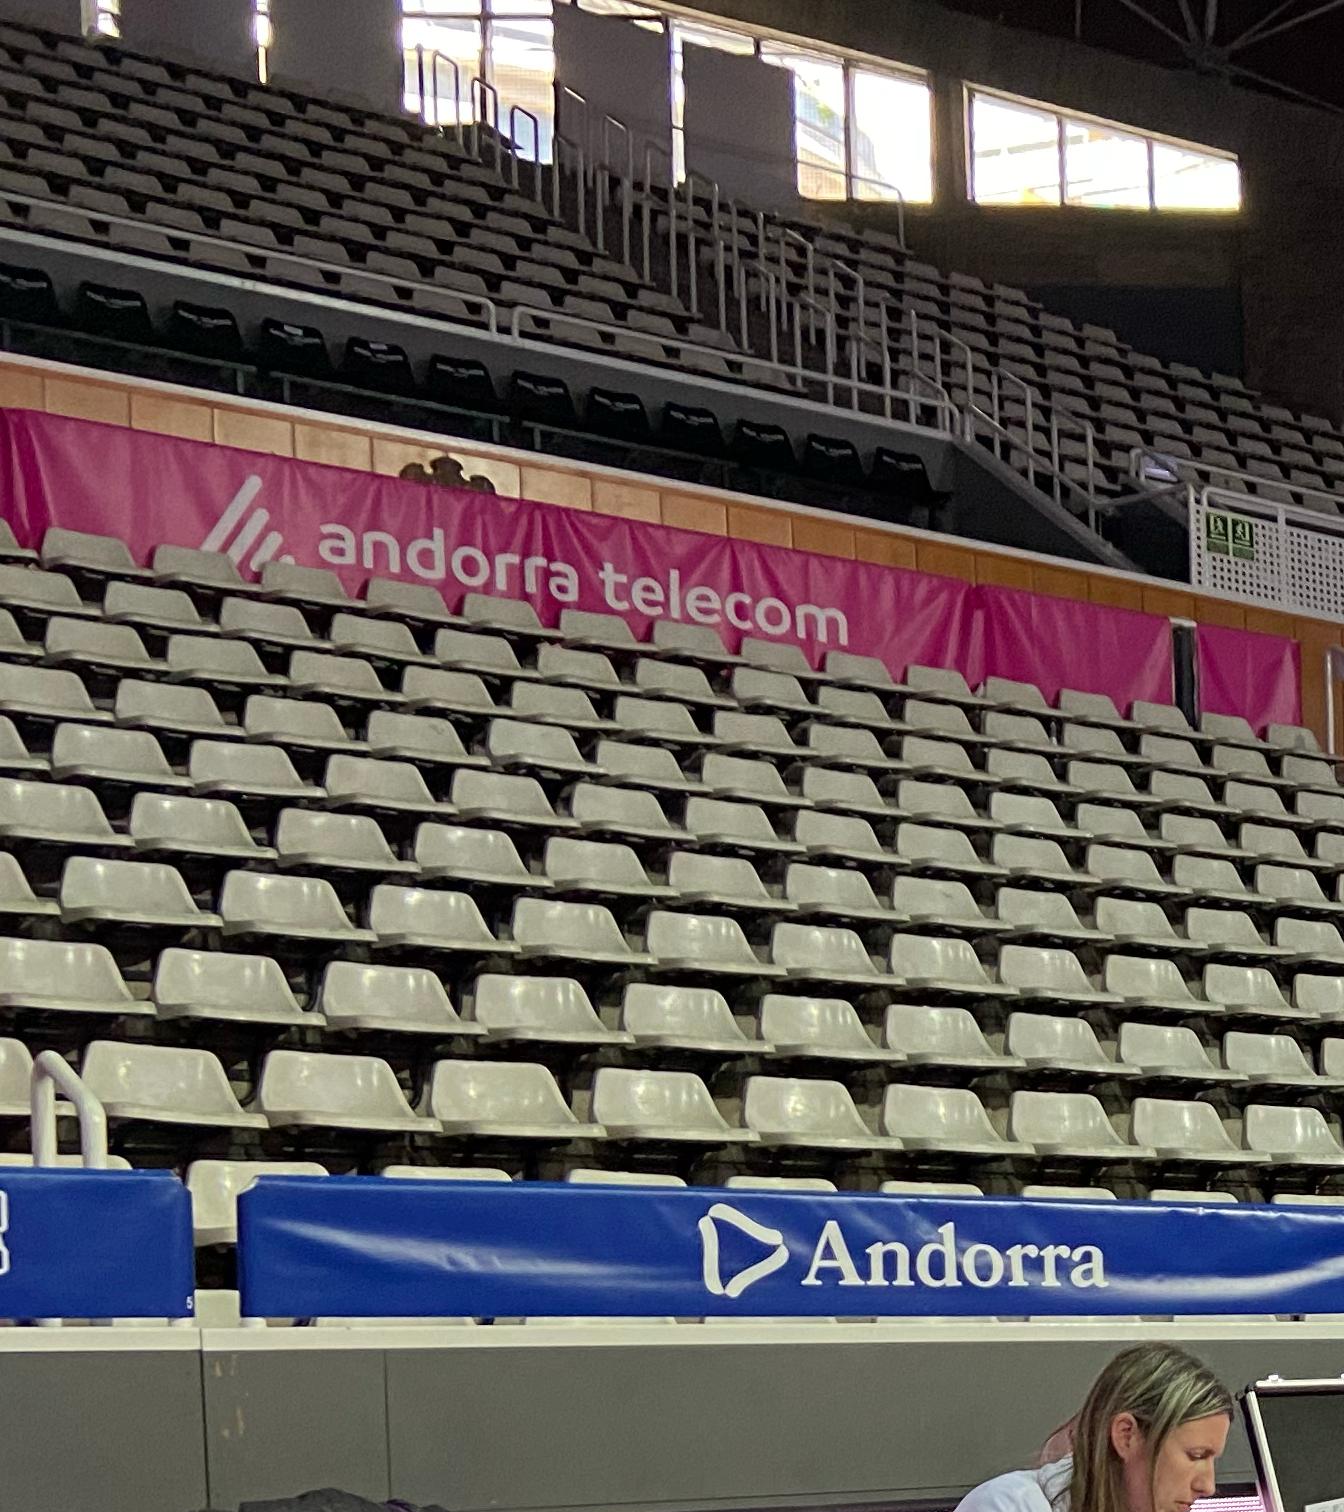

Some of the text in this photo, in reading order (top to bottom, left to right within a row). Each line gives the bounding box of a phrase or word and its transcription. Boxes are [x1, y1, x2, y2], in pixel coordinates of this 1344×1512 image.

[318, 522, 850, 646] andorra telecom
[800, 1220, 1109, 1290] Andorra
